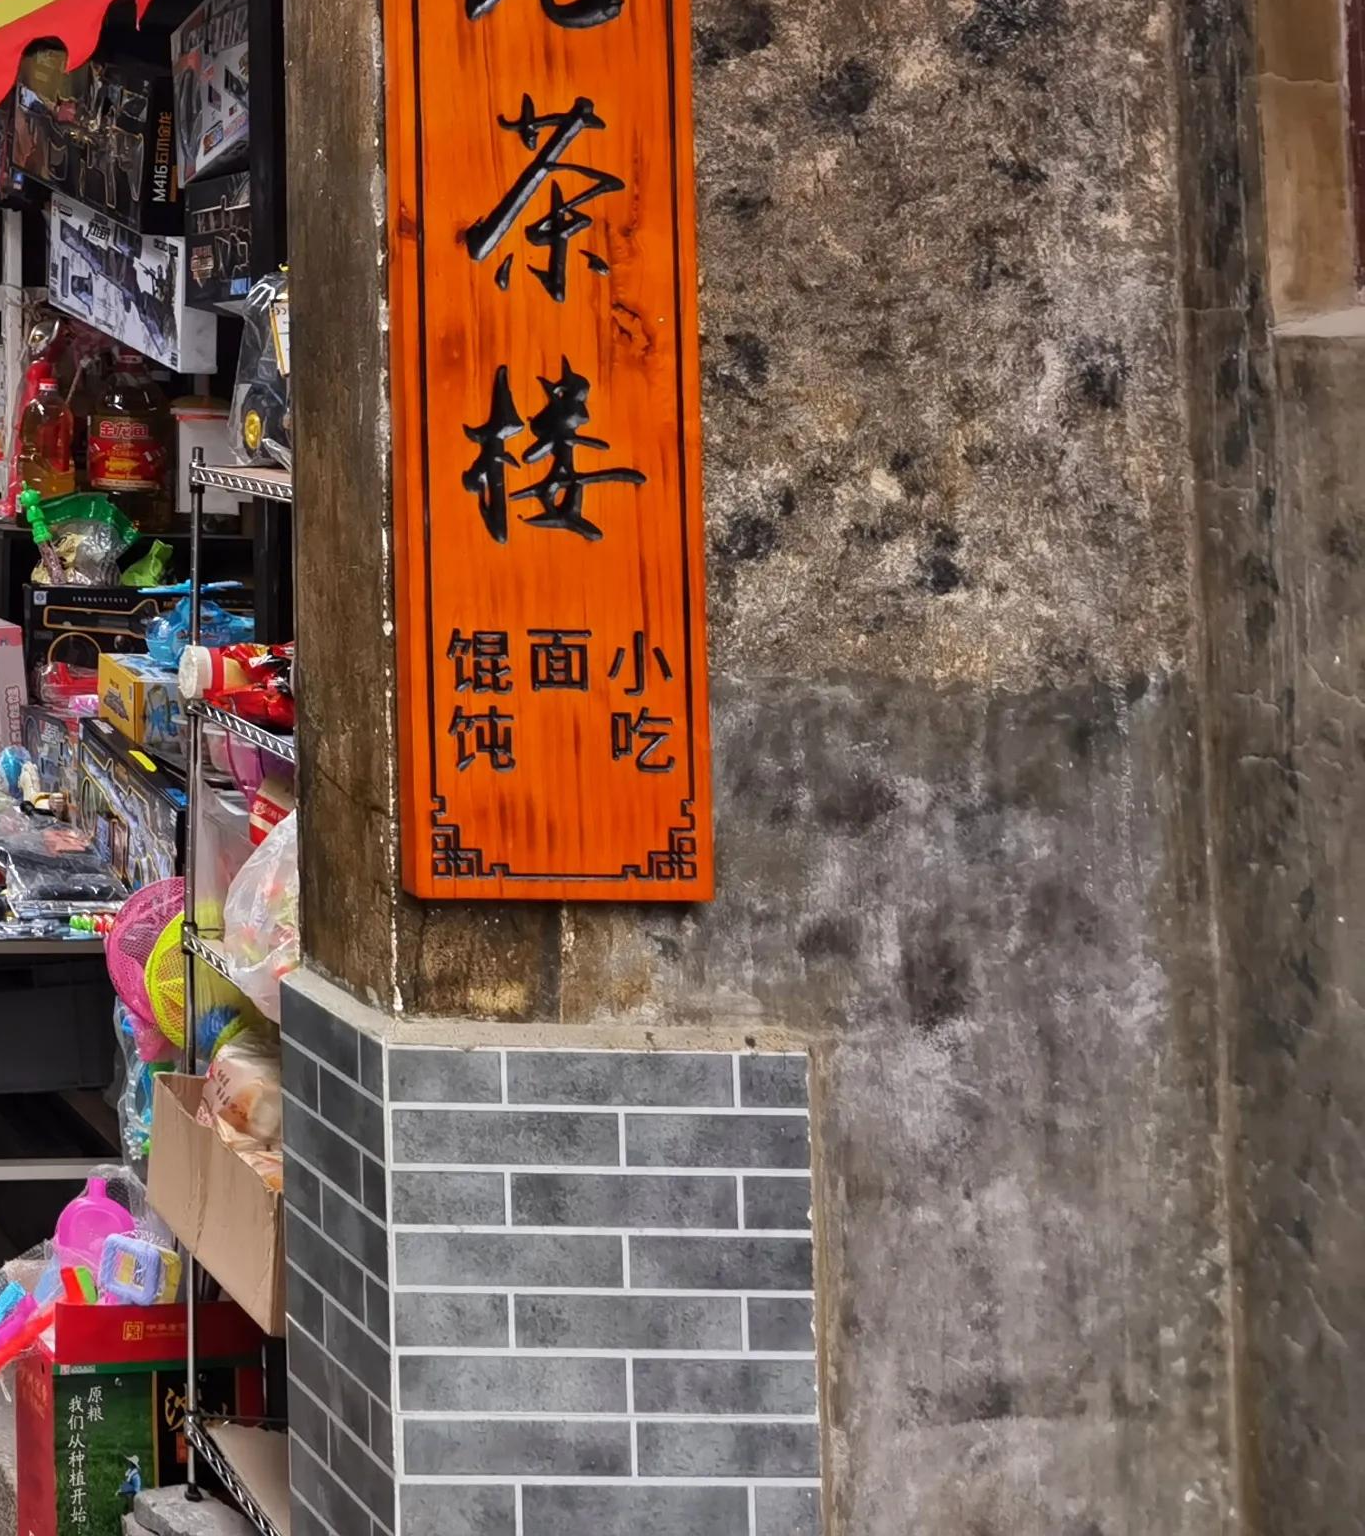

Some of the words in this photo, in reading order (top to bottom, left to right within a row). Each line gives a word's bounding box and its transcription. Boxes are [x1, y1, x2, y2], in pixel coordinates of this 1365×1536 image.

[447, 627, 517, 772] 馄饨
[526, 628, 592, 692] 面
[607, 630, 676, 773] 小吃
[68, 1394, 88, 1524] 我们从种植开始
[87, 1385, 104, 1421] 原粮
